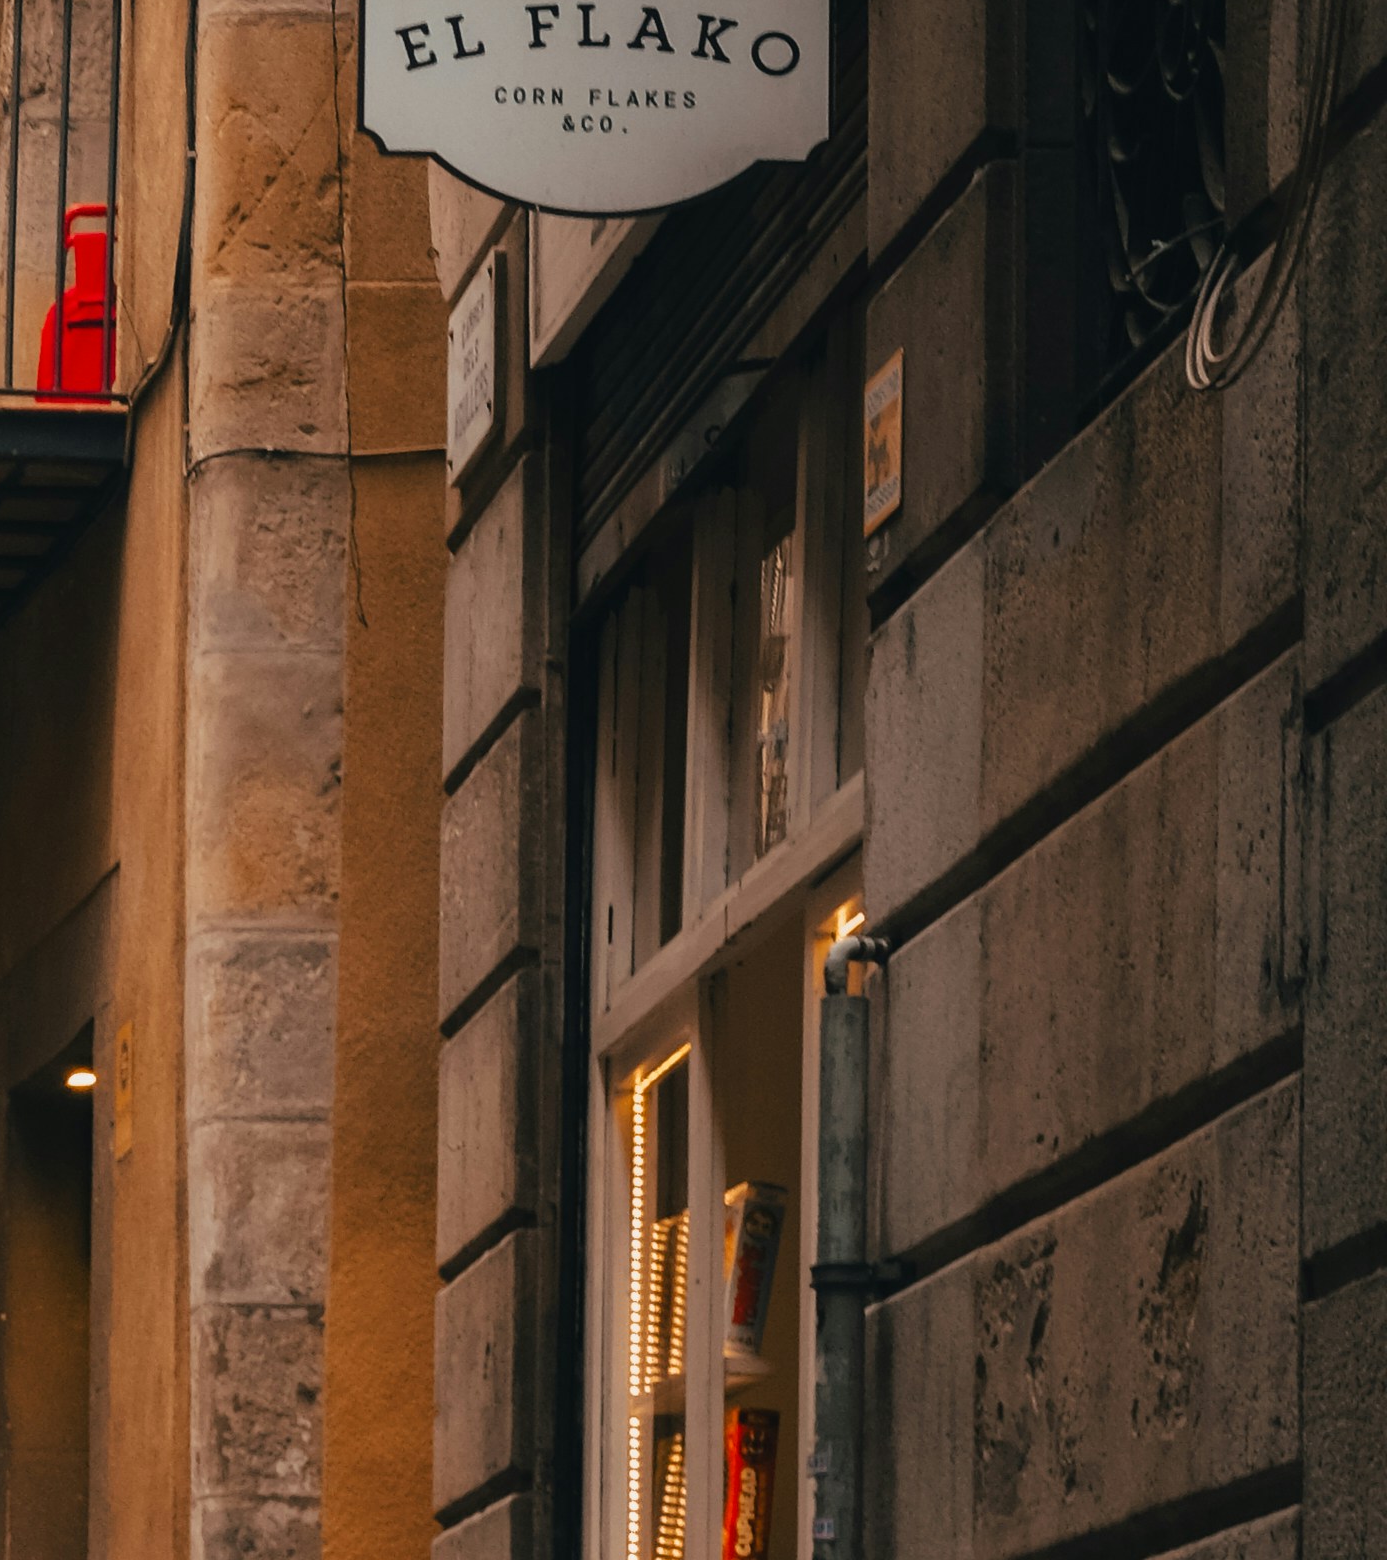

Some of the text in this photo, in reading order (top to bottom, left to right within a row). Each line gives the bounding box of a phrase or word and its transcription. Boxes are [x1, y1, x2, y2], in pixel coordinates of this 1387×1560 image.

[394, 2, 801, 77] EL FLAKO
[494, 86, 698, 109] CORN FLAKES
[561, 114, 629, 135] &CO.
[734, 1465, 758, 1558] CUPHEAD
